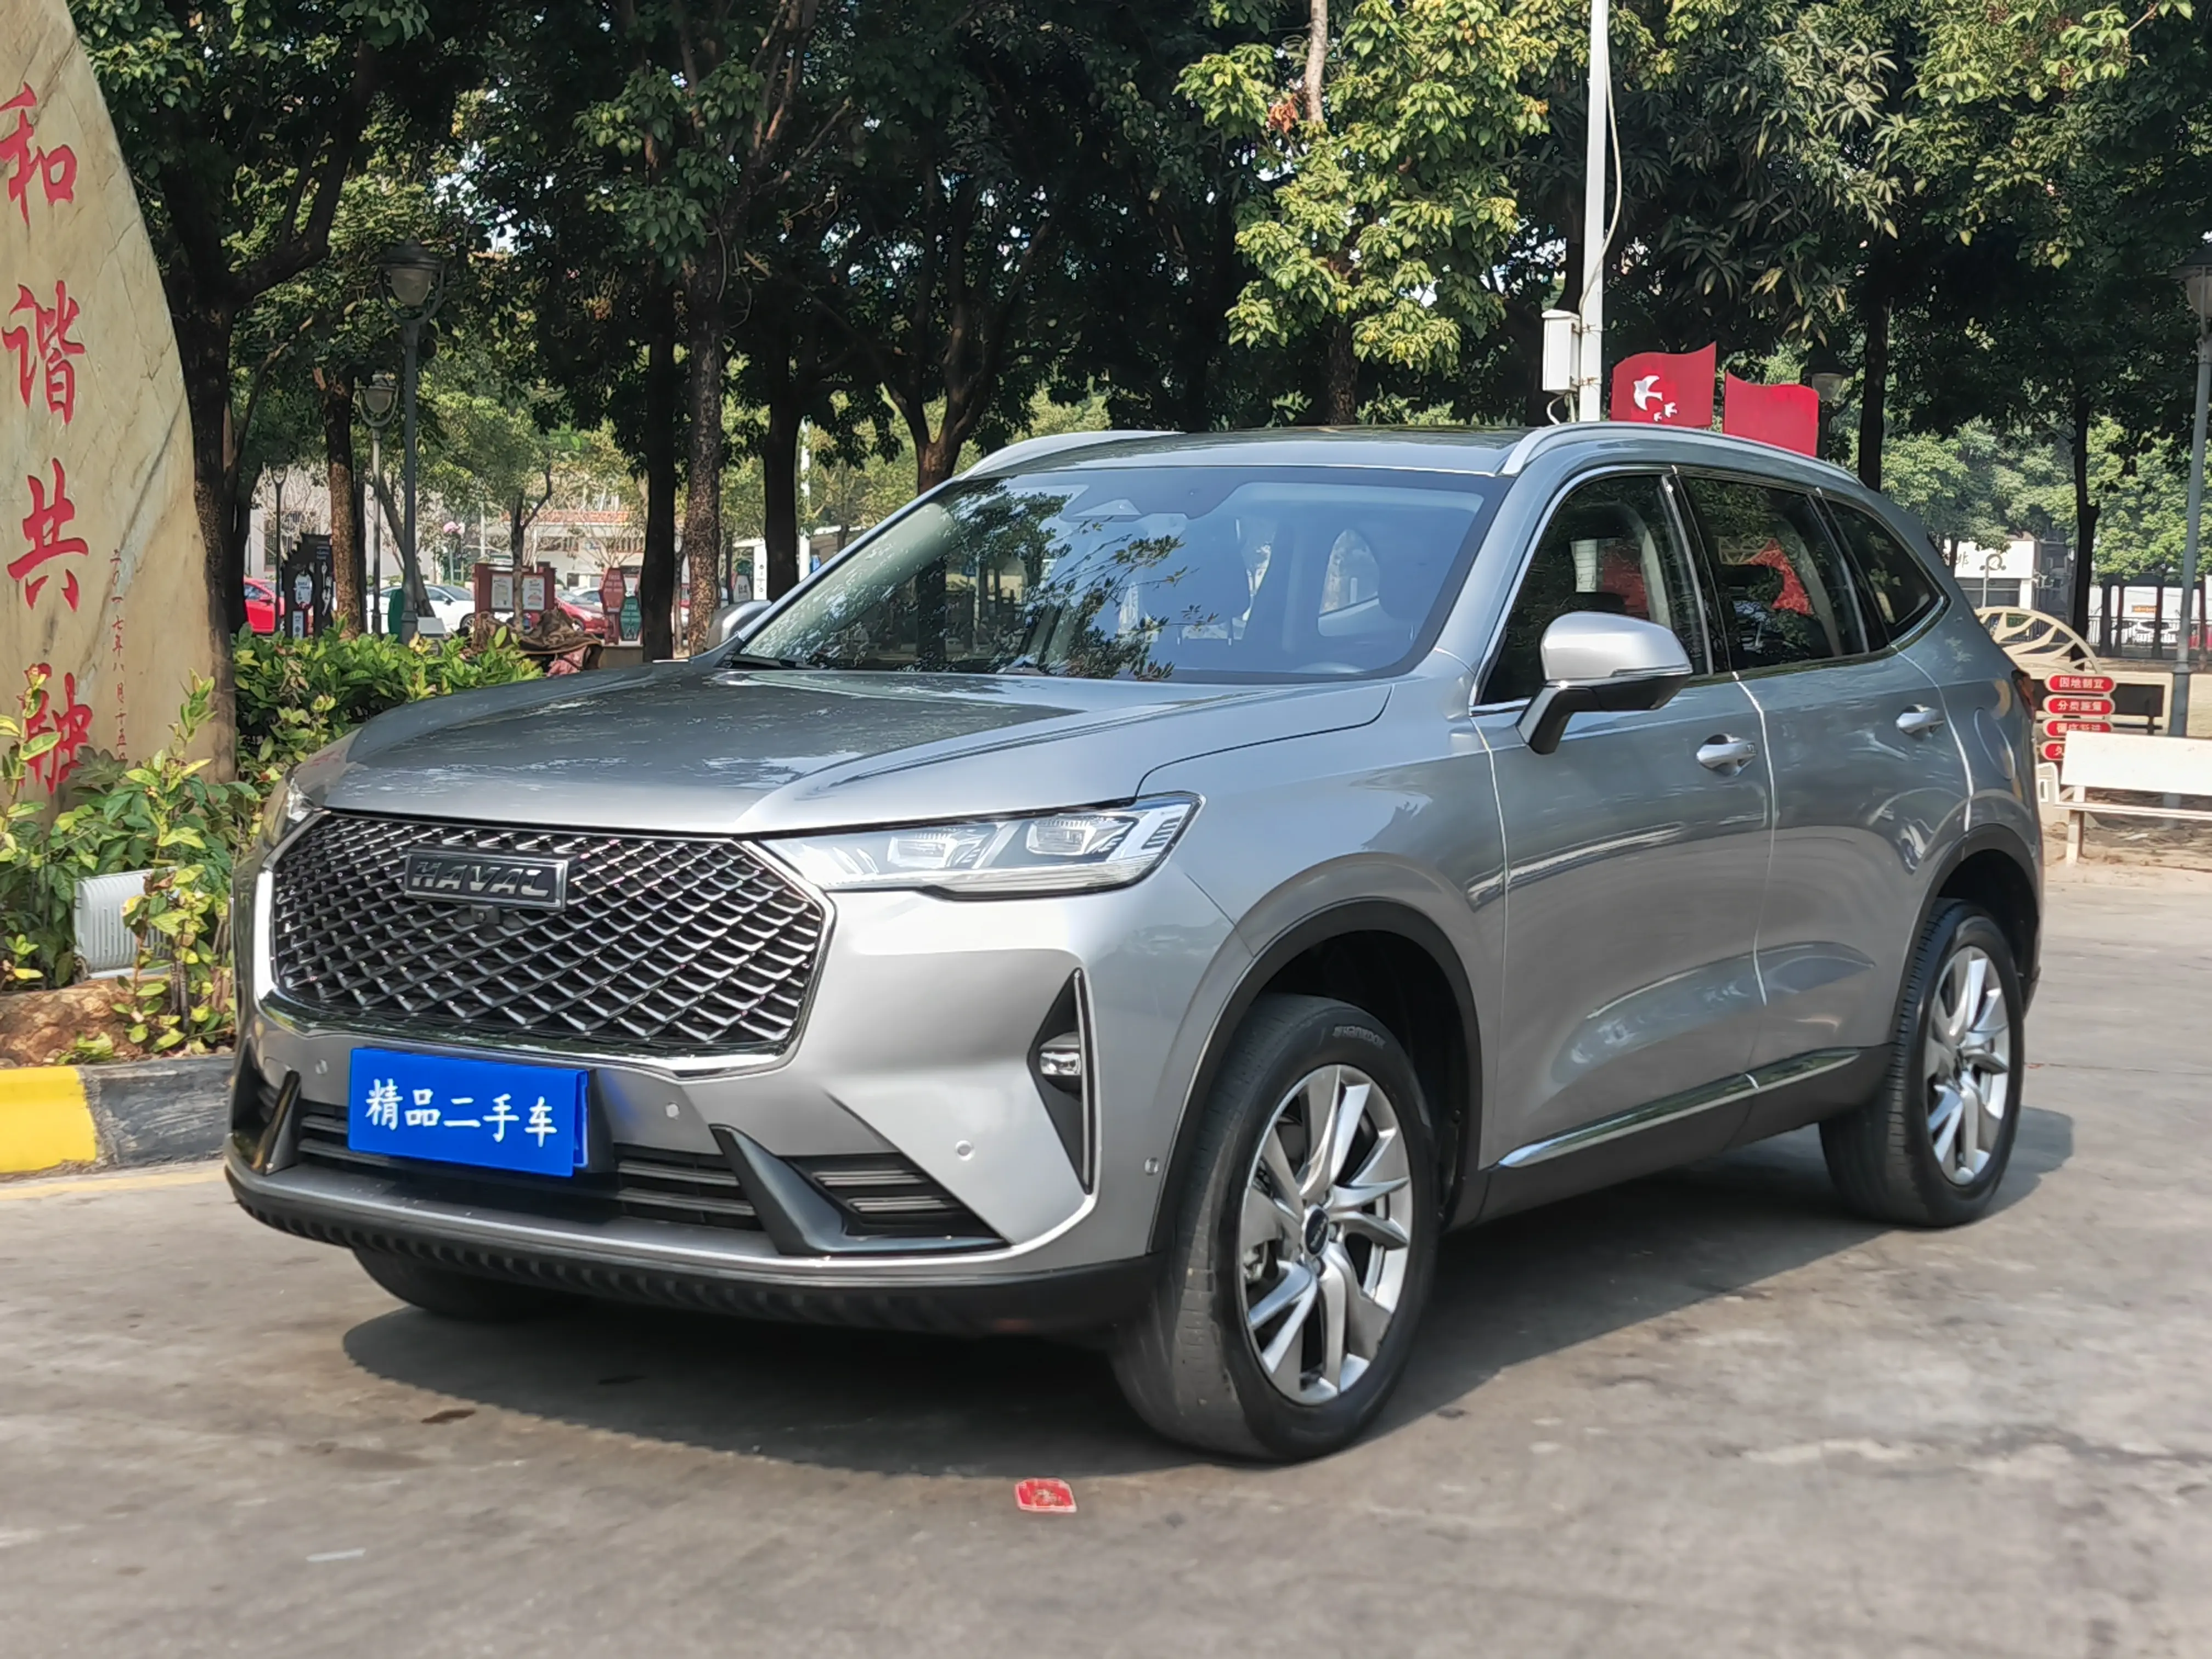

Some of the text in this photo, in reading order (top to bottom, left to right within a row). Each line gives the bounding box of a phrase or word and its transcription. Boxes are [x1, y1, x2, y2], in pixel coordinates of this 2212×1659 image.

[411, 861, 549, 898] HAVAL
[365, 1077, 558, 1148] 精品二手车
